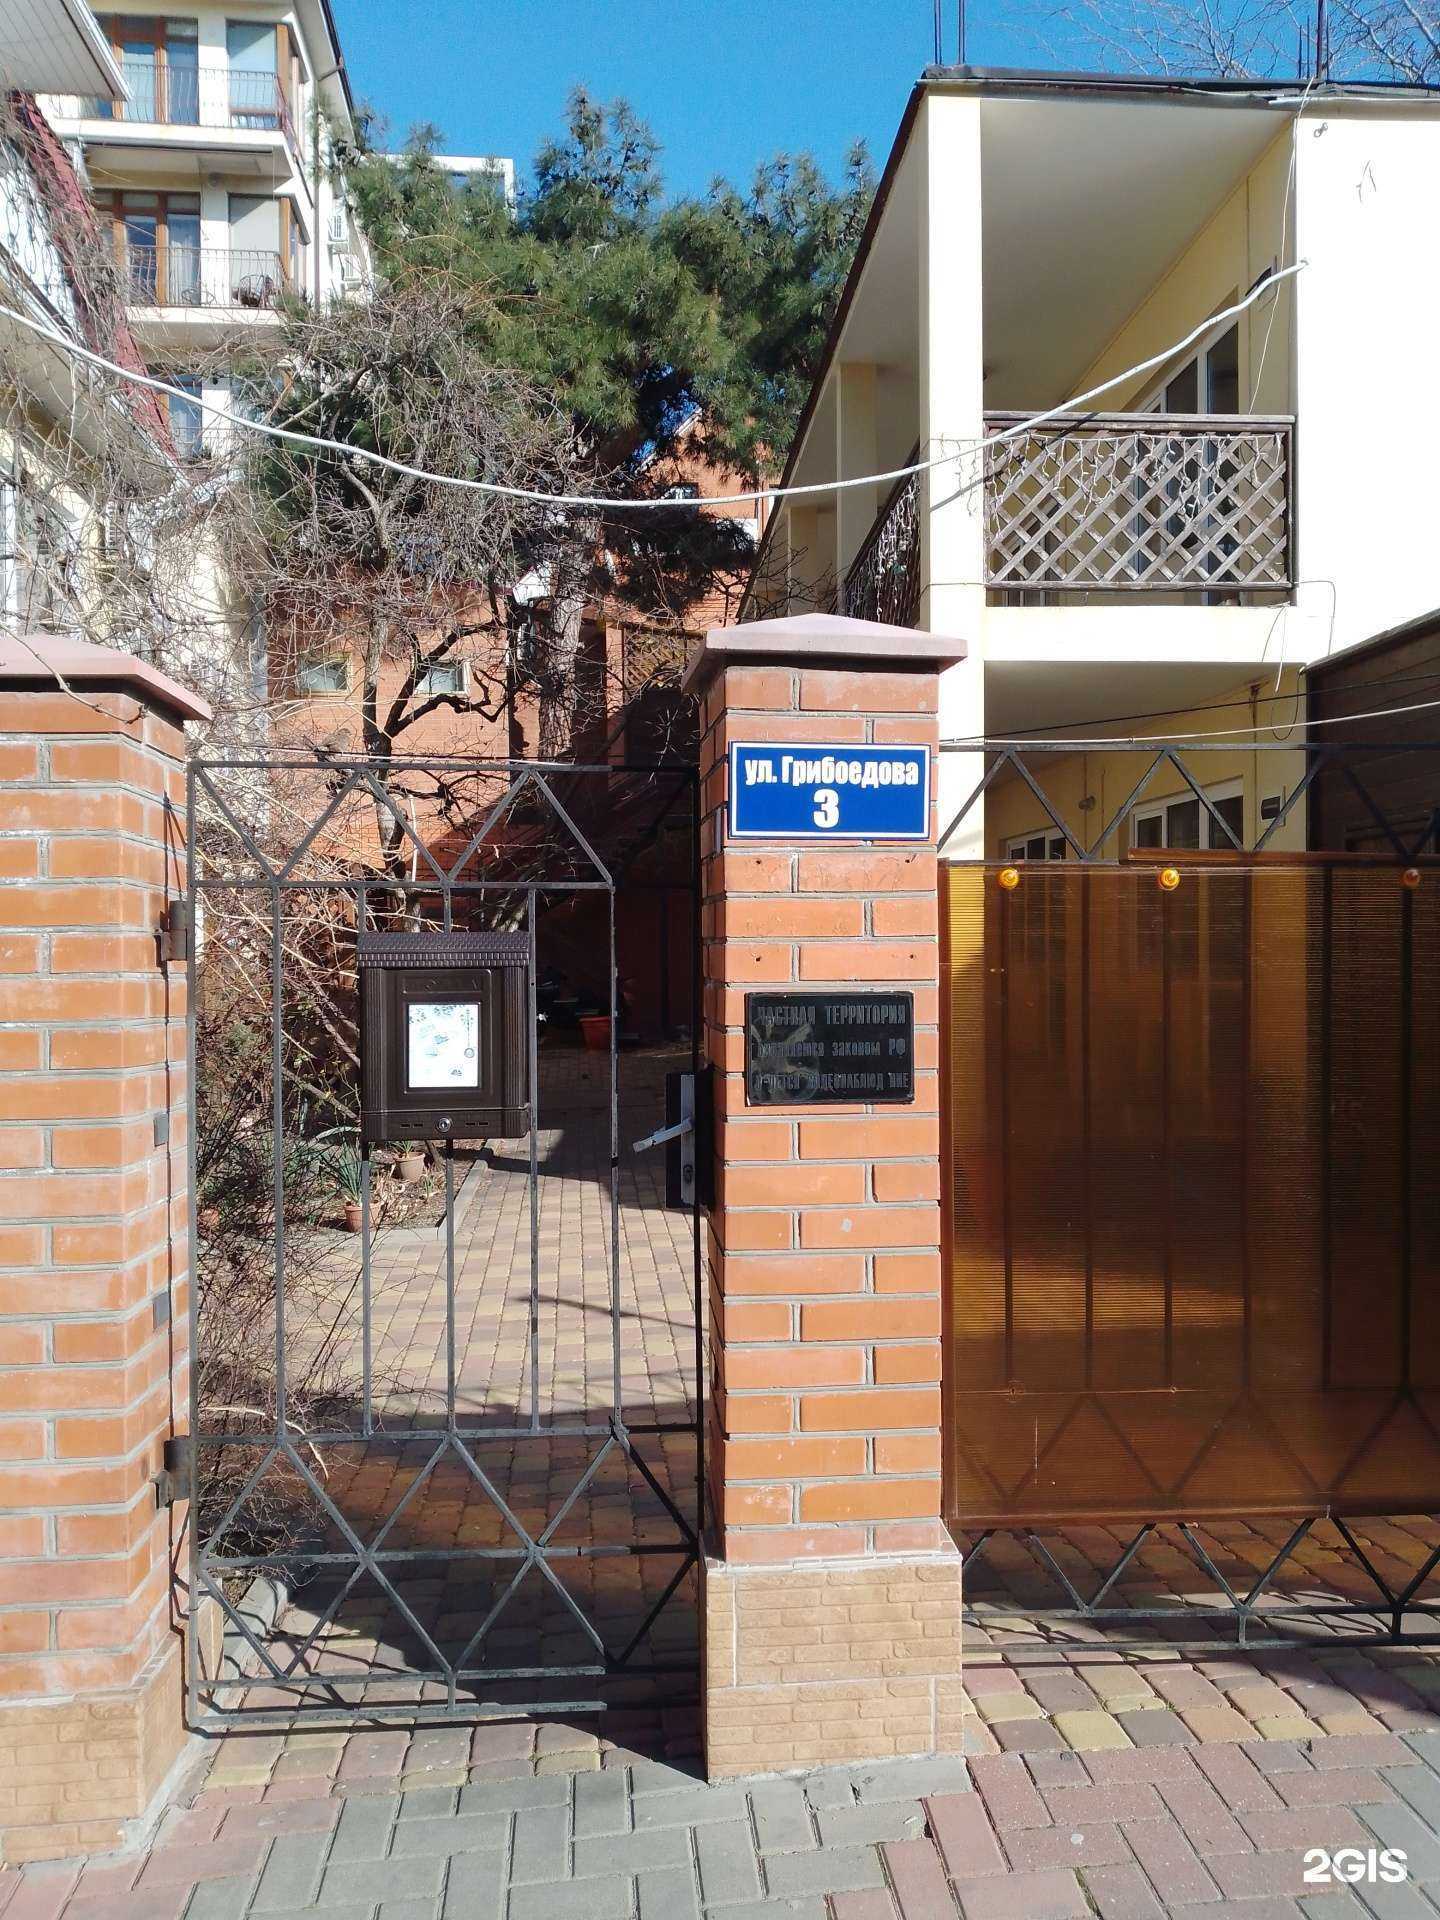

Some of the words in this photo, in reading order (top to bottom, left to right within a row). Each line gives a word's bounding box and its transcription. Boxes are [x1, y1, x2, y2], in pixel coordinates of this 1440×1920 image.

[744, 759, 778, 786] ул.
[781, 756, 919, 789] Грибоедова
[813, 788, 840, 829] 3
[824, 1004, 907, 1025] ТЕРРИТОРИЯ
[888, 1038, 906, 1056] РФ
